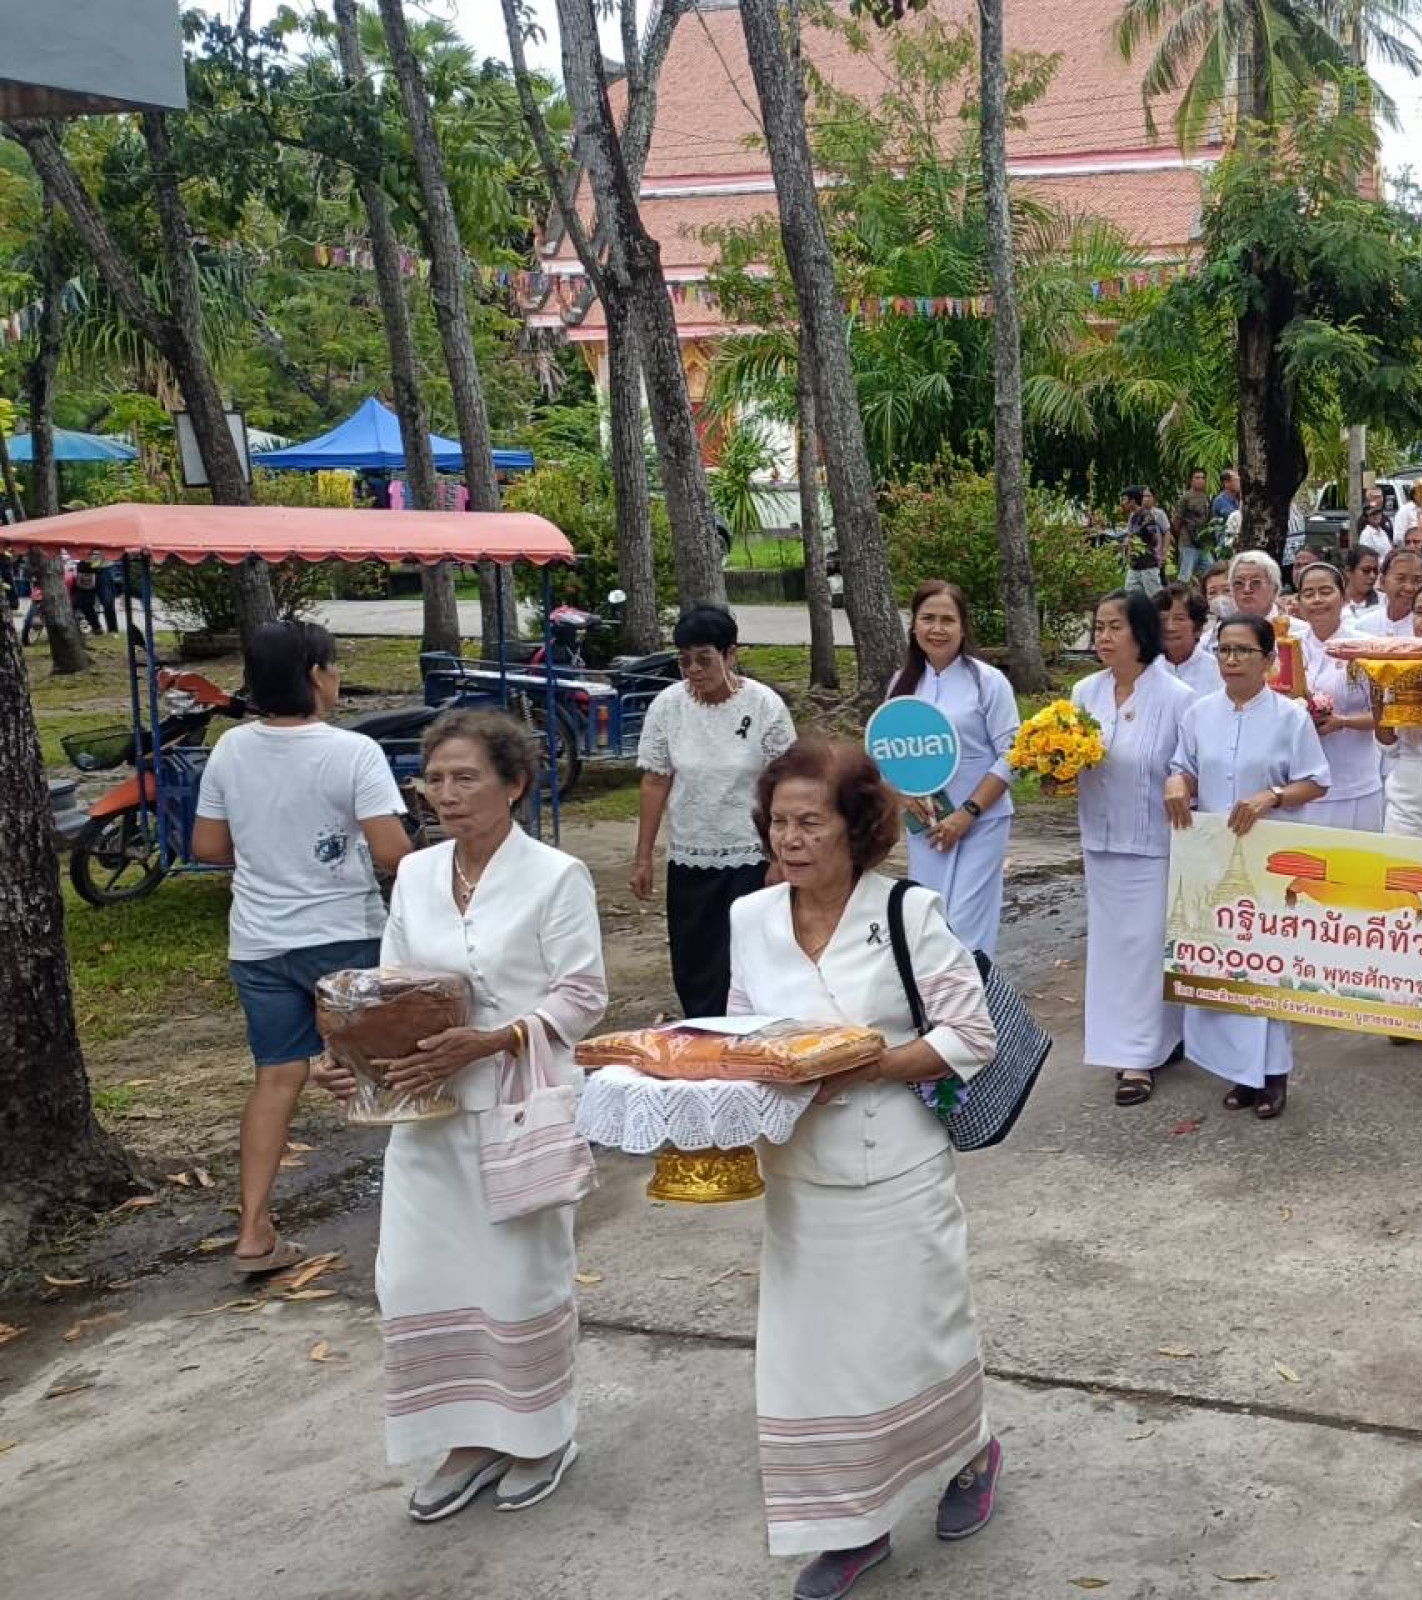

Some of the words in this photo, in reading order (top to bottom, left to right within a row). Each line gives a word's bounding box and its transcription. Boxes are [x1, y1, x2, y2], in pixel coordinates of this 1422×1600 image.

[872, 733, 954, 760] สงขลา
[1177, 943, 1284, 974] ๓๐,๐๐๐
[1293, 955, 1316, 979] วัด
